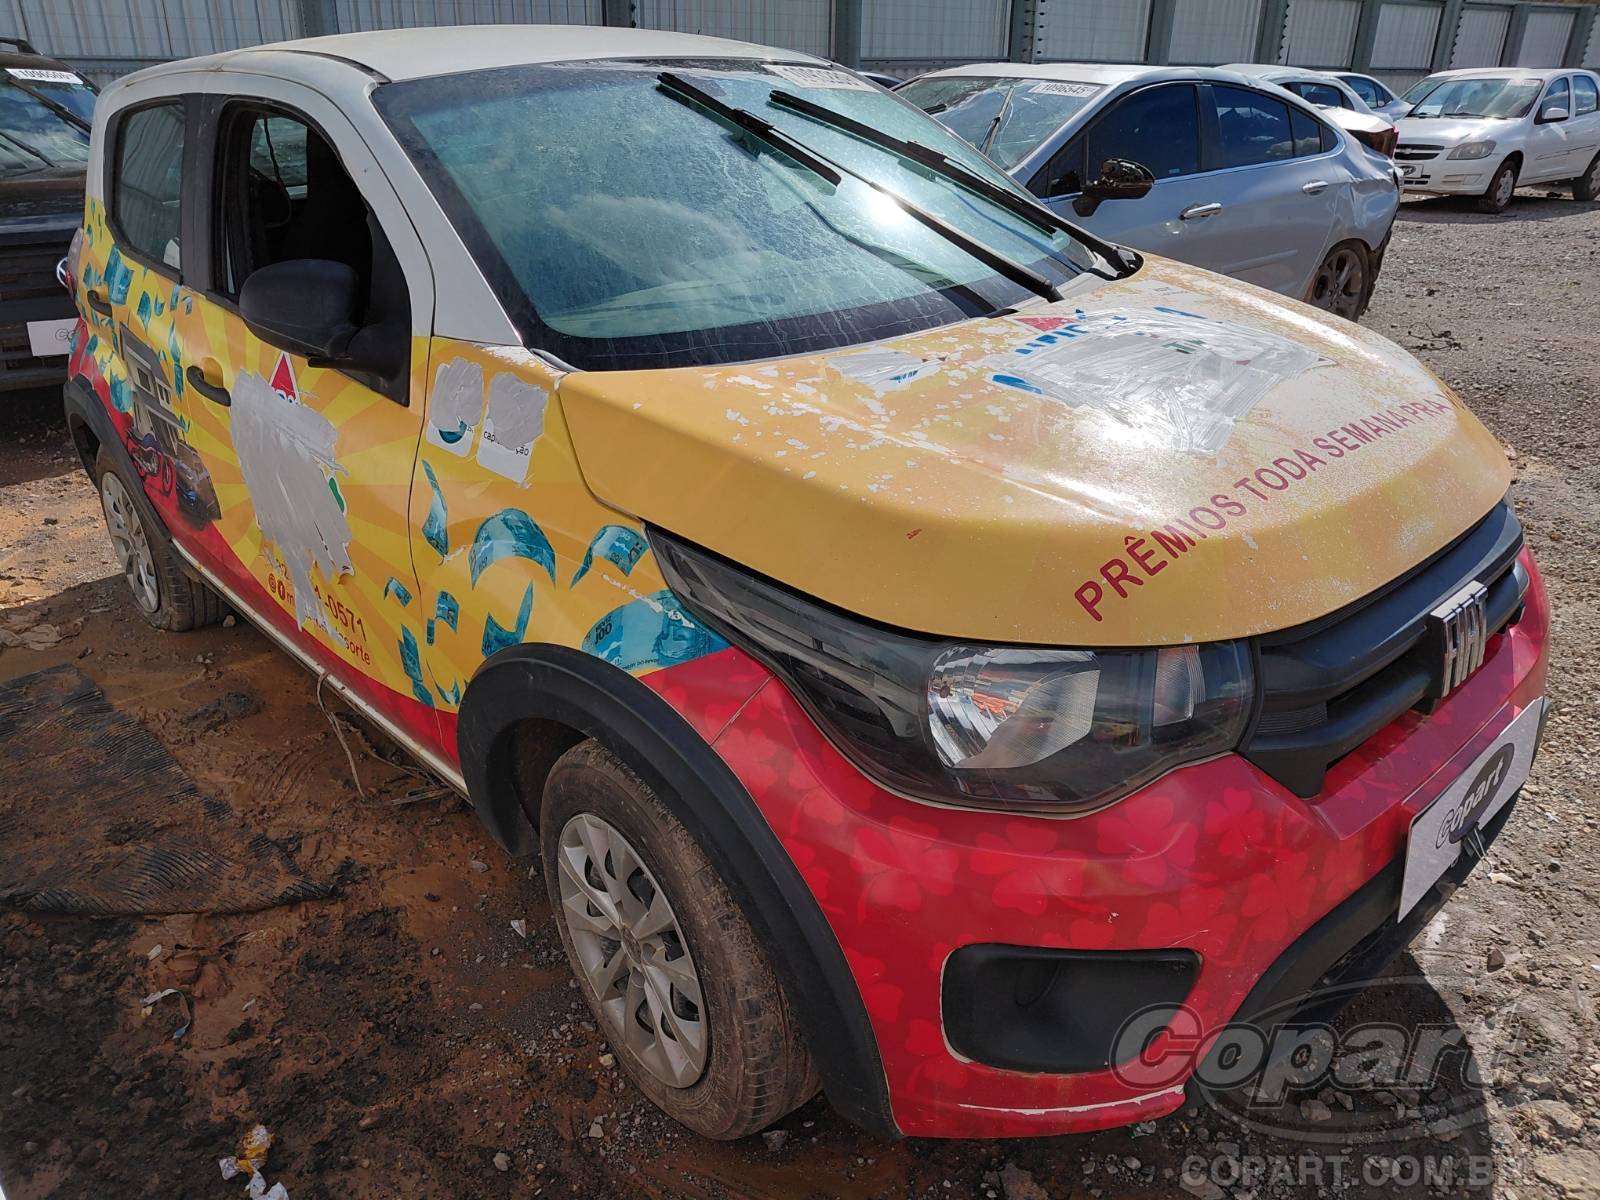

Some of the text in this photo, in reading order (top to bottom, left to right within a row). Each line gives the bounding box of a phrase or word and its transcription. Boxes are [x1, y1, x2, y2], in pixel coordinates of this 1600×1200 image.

[1074, 495, 1247, 622] PRÊMIOS
[1234, 448, 1327, 501] TODA
[1313, 410, 1416, 458] SEMANA
[1400, 399, 1450, 422] PRA
[1436, 755, 1506, 850] Copart
